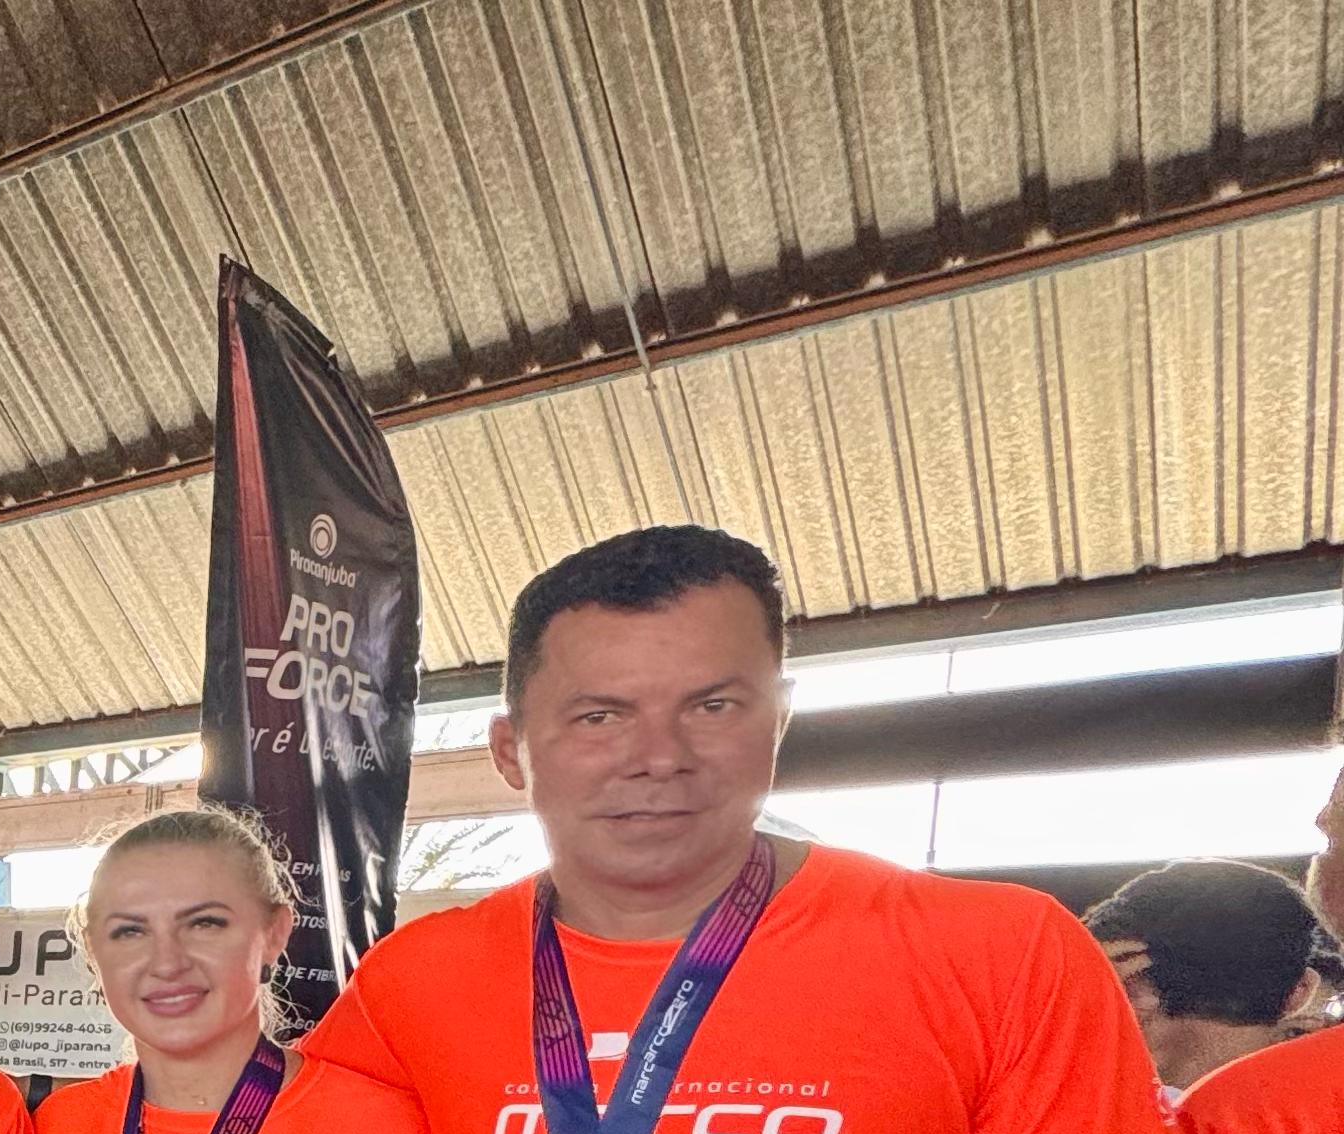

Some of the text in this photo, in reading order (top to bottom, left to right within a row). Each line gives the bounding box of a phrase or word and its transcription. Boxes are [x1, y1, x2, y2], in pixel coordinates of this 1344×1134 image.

[290, 549, 357, 588] Piracanjuba
[280, 593, 355, 658] PRO
[245, 648, 379, 719] FORCE
[291, 861, 313, 876] EM
